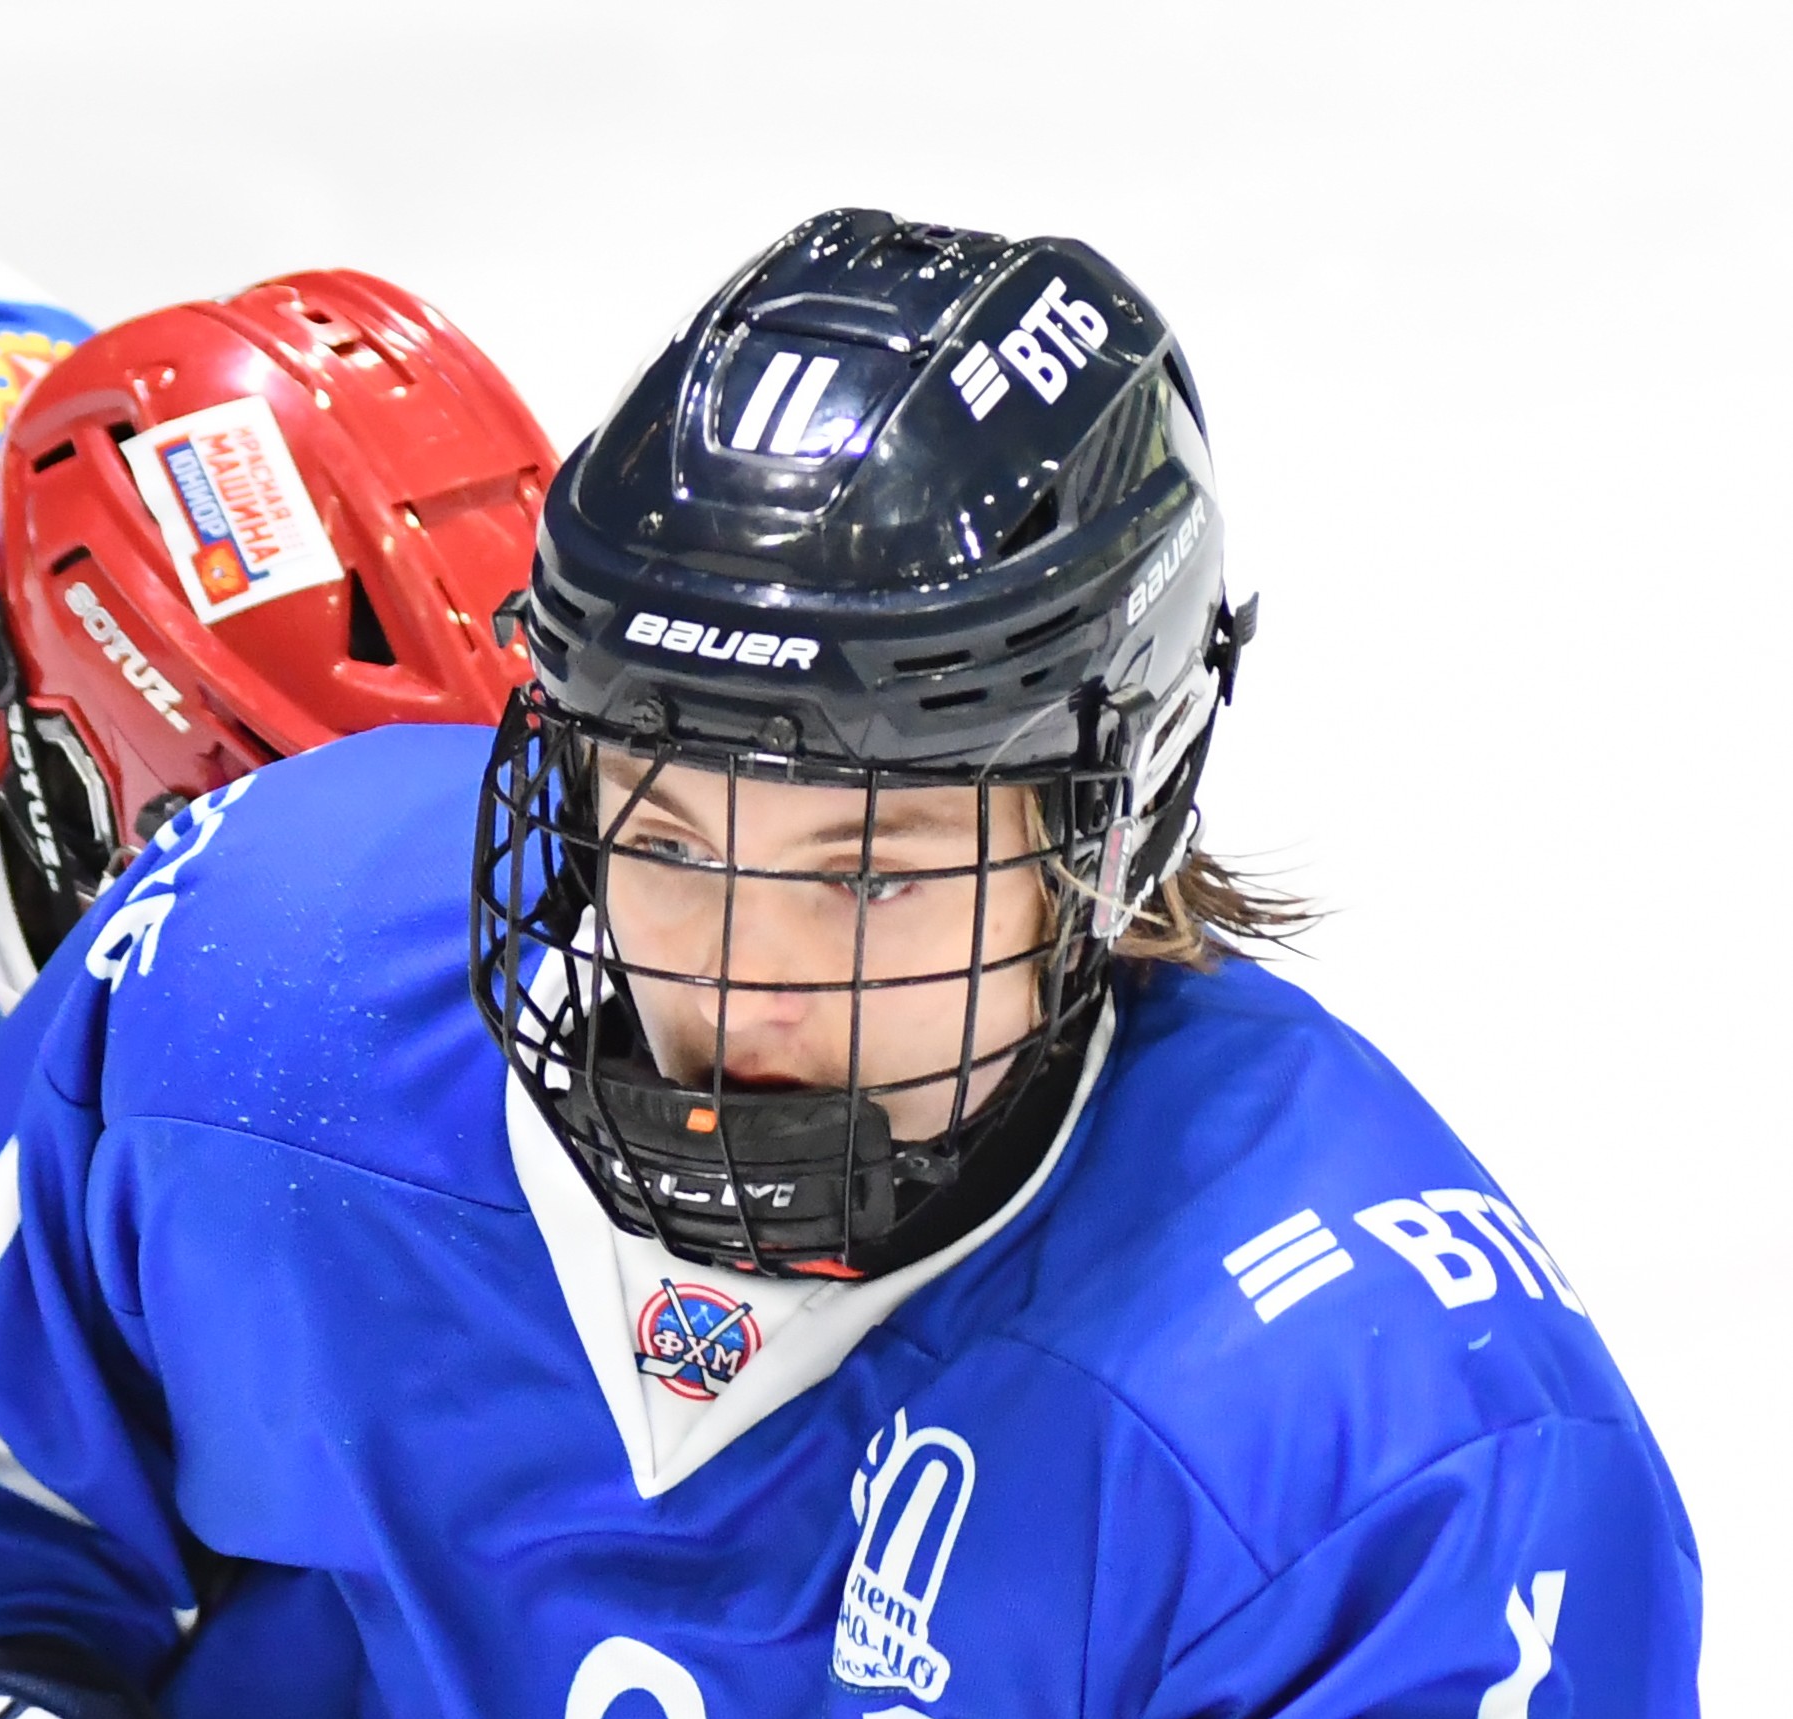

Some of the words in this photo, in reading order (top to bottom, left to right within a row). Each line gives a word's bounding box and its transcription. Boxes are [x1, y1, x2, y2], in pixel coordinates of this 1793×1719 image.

[999, 276, 1108, 404] ВТБ
[166, 447, 229, 538] ЮНИОР
[199, 432, 280, 563] МАШИНА
[64, 581, 184, 716] SOYUZ
[653, 1328, 743, 1378] ФХМ
